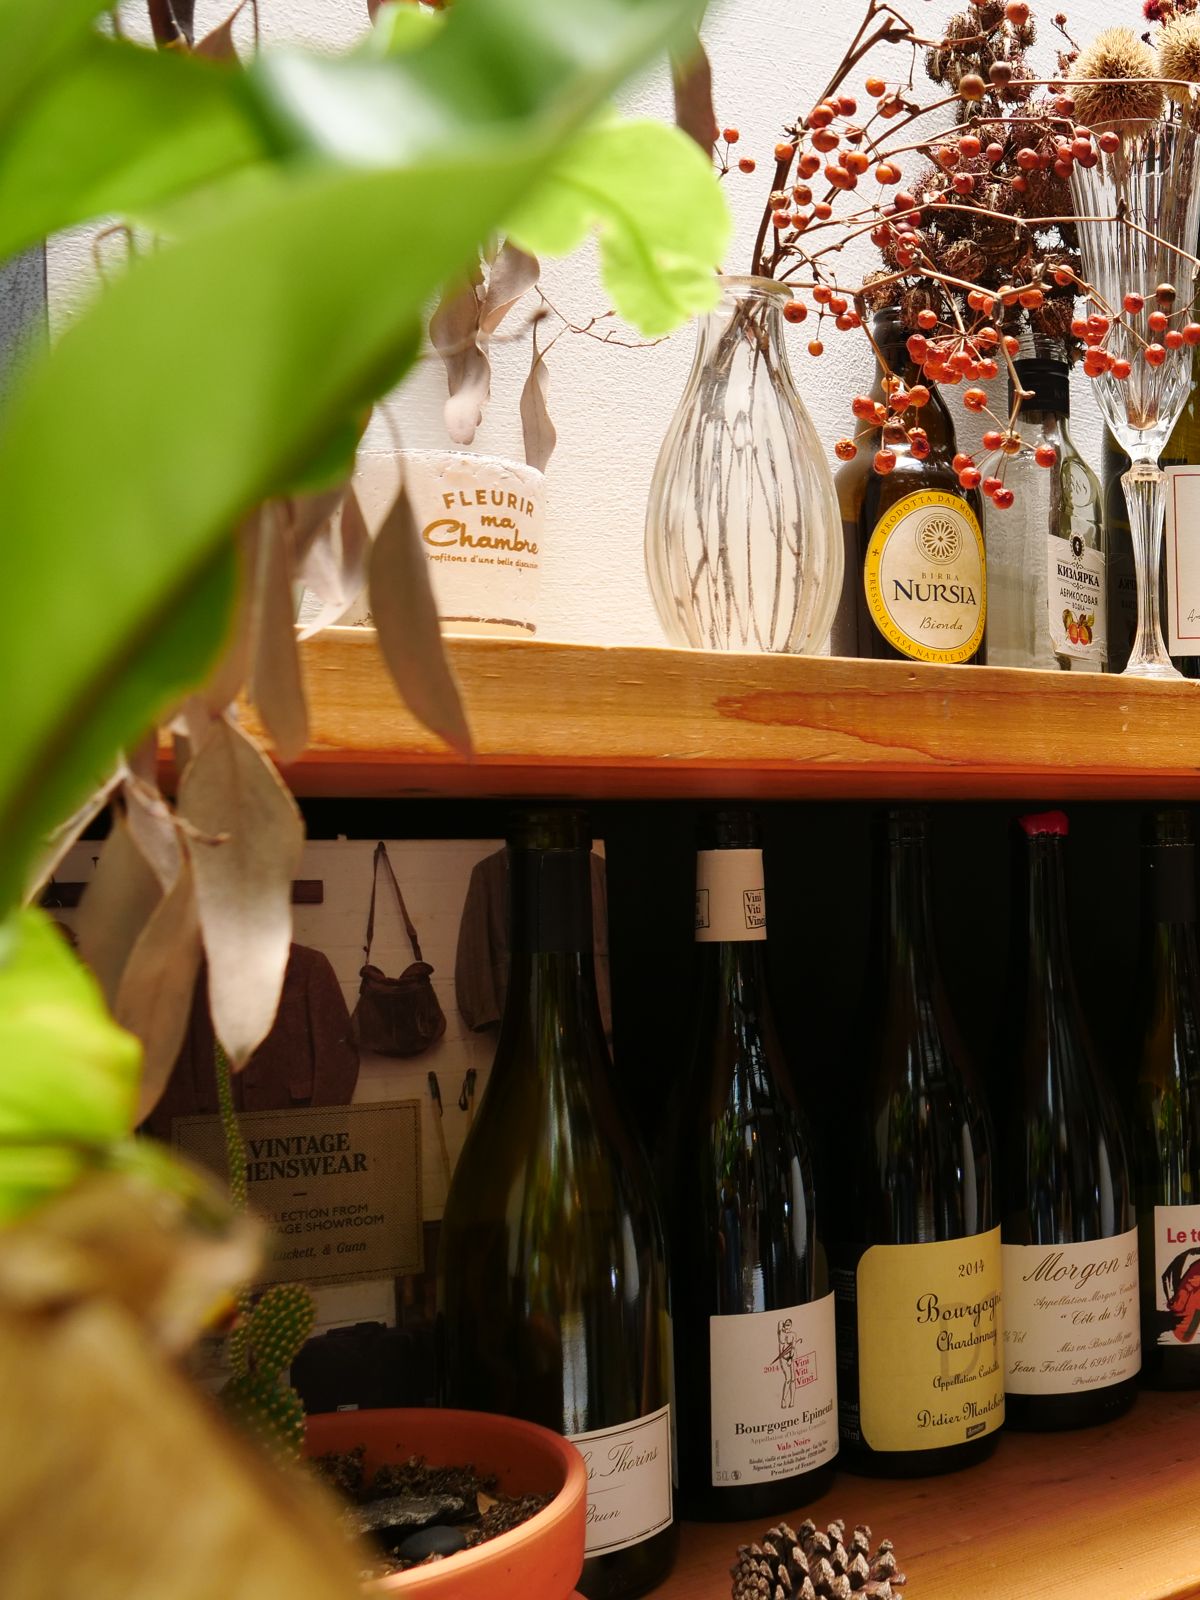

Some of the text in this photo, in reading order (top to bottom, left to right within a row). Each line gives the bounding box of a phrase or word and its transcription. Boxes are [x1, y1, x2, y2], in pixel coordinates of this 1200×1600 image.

[442, 489, 535, 517] FLEURIR
[480, 513, 516, 529] ma
[881, 495, 933, 535] PRODOTTA
[938, 496, 956, 505] DAI
[421, 518, 539, 555] Chambre
[470, 554, 494, 565] d'une
[496, 557, 514, 567] belle
[922, 572, 959, 581] BIRRA
[1057, 564, 1100, 587] КИЗЛЯРКА
[1060, 588, 1098, 605] АБРИКОСОВАЯ
[870, 572, 881, 612] PRESSO
[880, 616, 889, 628] LA
[889, 629, 912, 651] CASA
[916, 648, 954, 662] NATALE
[919, 616, 963, 630] Bionda
[746, 904, 761, 914] Viti
[250, 1132, 350, 1160] VINTAGE
[331, 1203, 369, 1217] FROM
[305, 1214, 384, 1231] SHOWROOM
[1167, 1227, 1187, 1243] Le
[321, 1244, 331, 1256] &
[336, 1241, 367, 1254] Gunn
[958, 1259, 985, 1278] 2014
[1022, 1252, 1120, 1290] Morgon
[1033, 1295, 1088, 1311] Appellation
[1098, 1307, 1111, 1322] du
[936, 1328, 998, 1352] Chardonnay
[1057, 1342, 1076, 1353] Mis
[1076, 1344, 1087, 1353] en
[763, 1365, 780, 1375] 2014
[795, 1358, 810, 1368] Vini
[1009, 1361, 1036, 1375] Jean
[1089, 1353, 1117, 1368] 69910
[795, 1368, 809, 1378] Viti
[796, 1374, 815, 1386] Vinci
[933, 1374, 977, 1392] Appellation
[917, 1408, 962, 1428] Didier
[735, 1418, 800, 1436] Bourgogne
[776, 1442, 793, 1452] Vals
[793, 1437, 812, 1448] Noirs
[600, 1440, 658, 1478] Thorins
